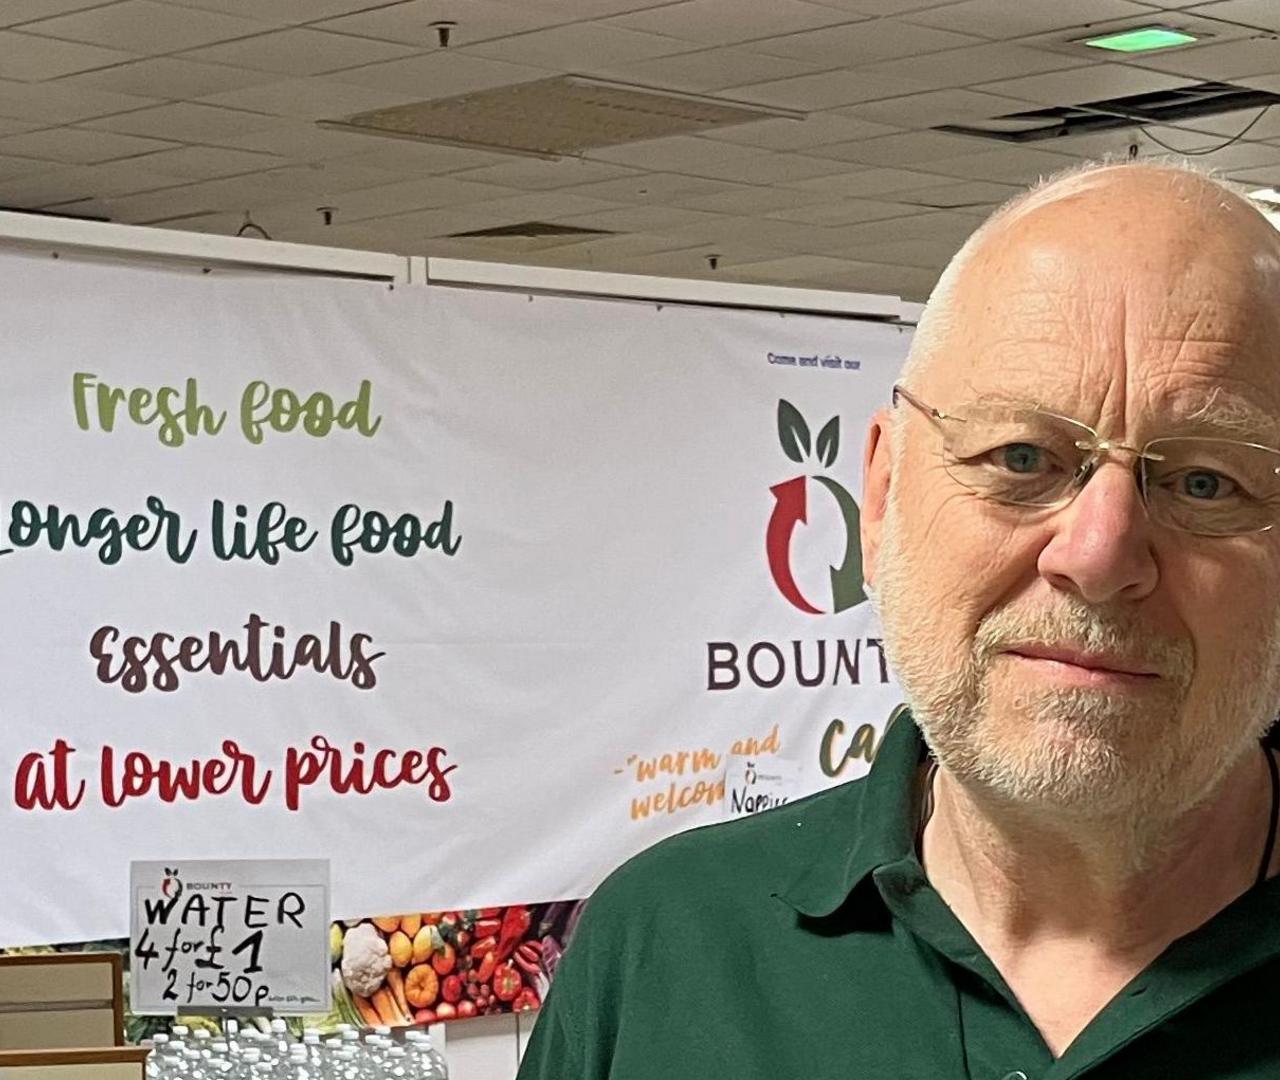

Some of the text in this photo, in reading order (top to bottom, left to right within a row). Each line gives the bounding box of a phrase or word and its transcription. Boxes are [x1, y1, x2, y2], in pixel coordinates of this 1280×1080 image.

[73, 371, 382, 447] Fresh food
[212, 499, 318, 565] life
[331, 500, 462, 567] food
[89, 612, 387, 693] Essentials
[707, 638, 891, 691] BOUNT
[730, 722, 781, 757] and
[13, 735, 458, 811] at lower prices
[144, 892, 306, 929] WATER
[186, 883, 233, 891] BOUNTY
[134, 927, 160, 971] 4
[161, 927, 205, 972] for
[162, 968, 269, 1008] 2 for 50p
